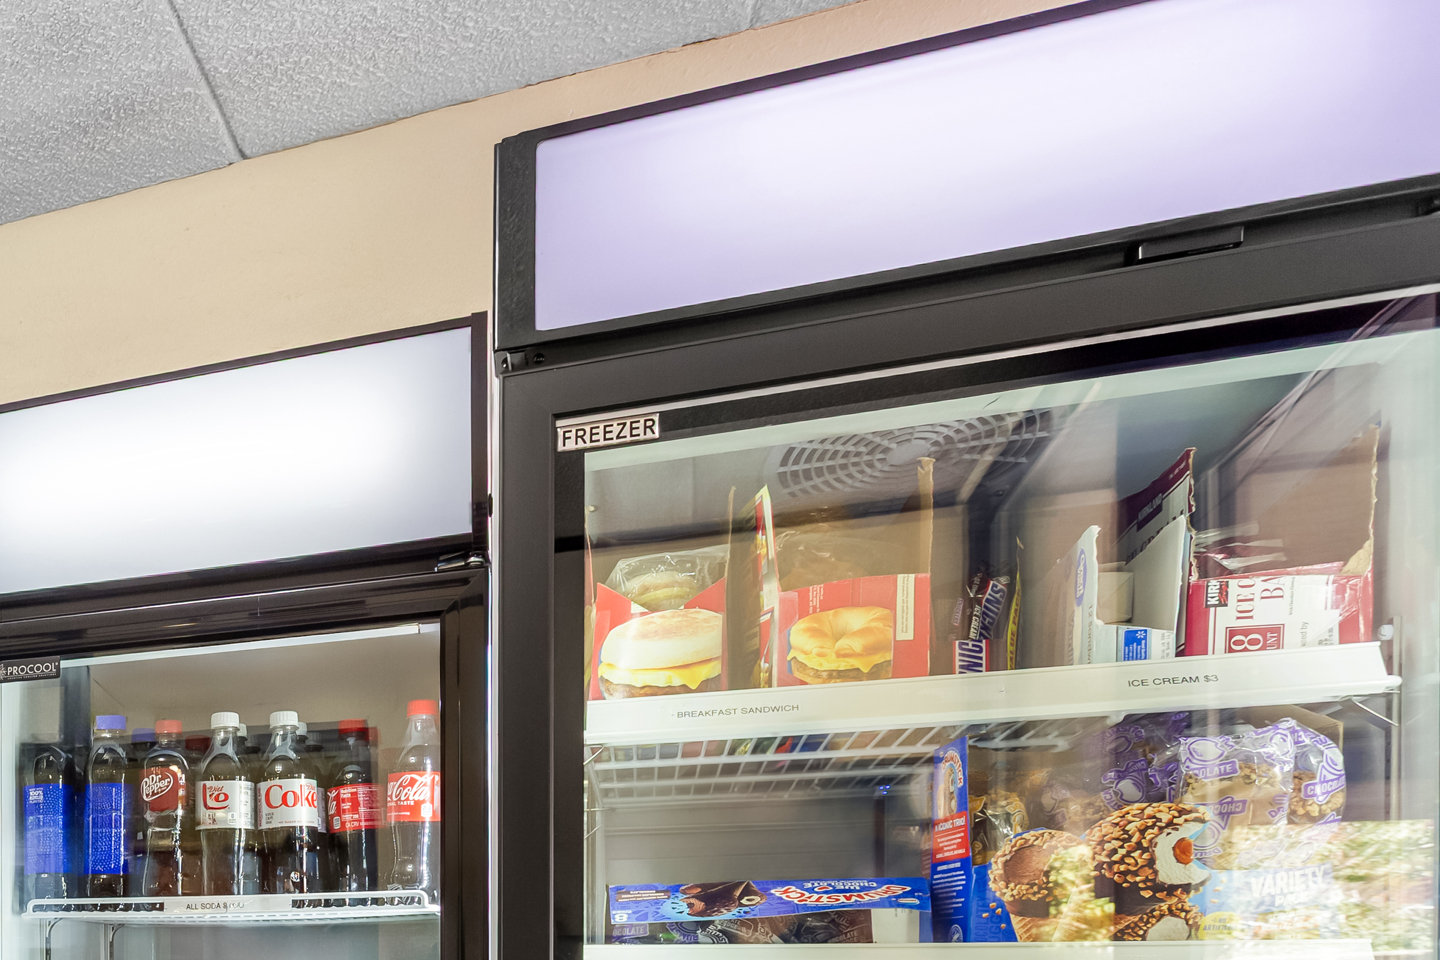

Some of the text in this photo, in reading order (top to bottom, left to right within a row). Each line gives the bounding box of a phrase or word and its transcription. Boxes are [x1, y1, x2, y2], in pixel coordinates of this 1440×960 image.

[561, 417, 657, 448] FREEZER
[1236, 593, 1255, 620] ICE
[1231, 633, 1264, 651] 8
[7, 662, 57, 676] PROCOOL
[1127, 674, 1219, 688] ICE CREAM $3
[676, 704, 800, 718] BREAKFAST SANDWICH
[142, 772, 171, 798] Dr Pepper
[264, 784, 318, 809] Coke
[771, 884, 911, 906] DRUMSTICK
[200, 902, 223, 910] SODA
